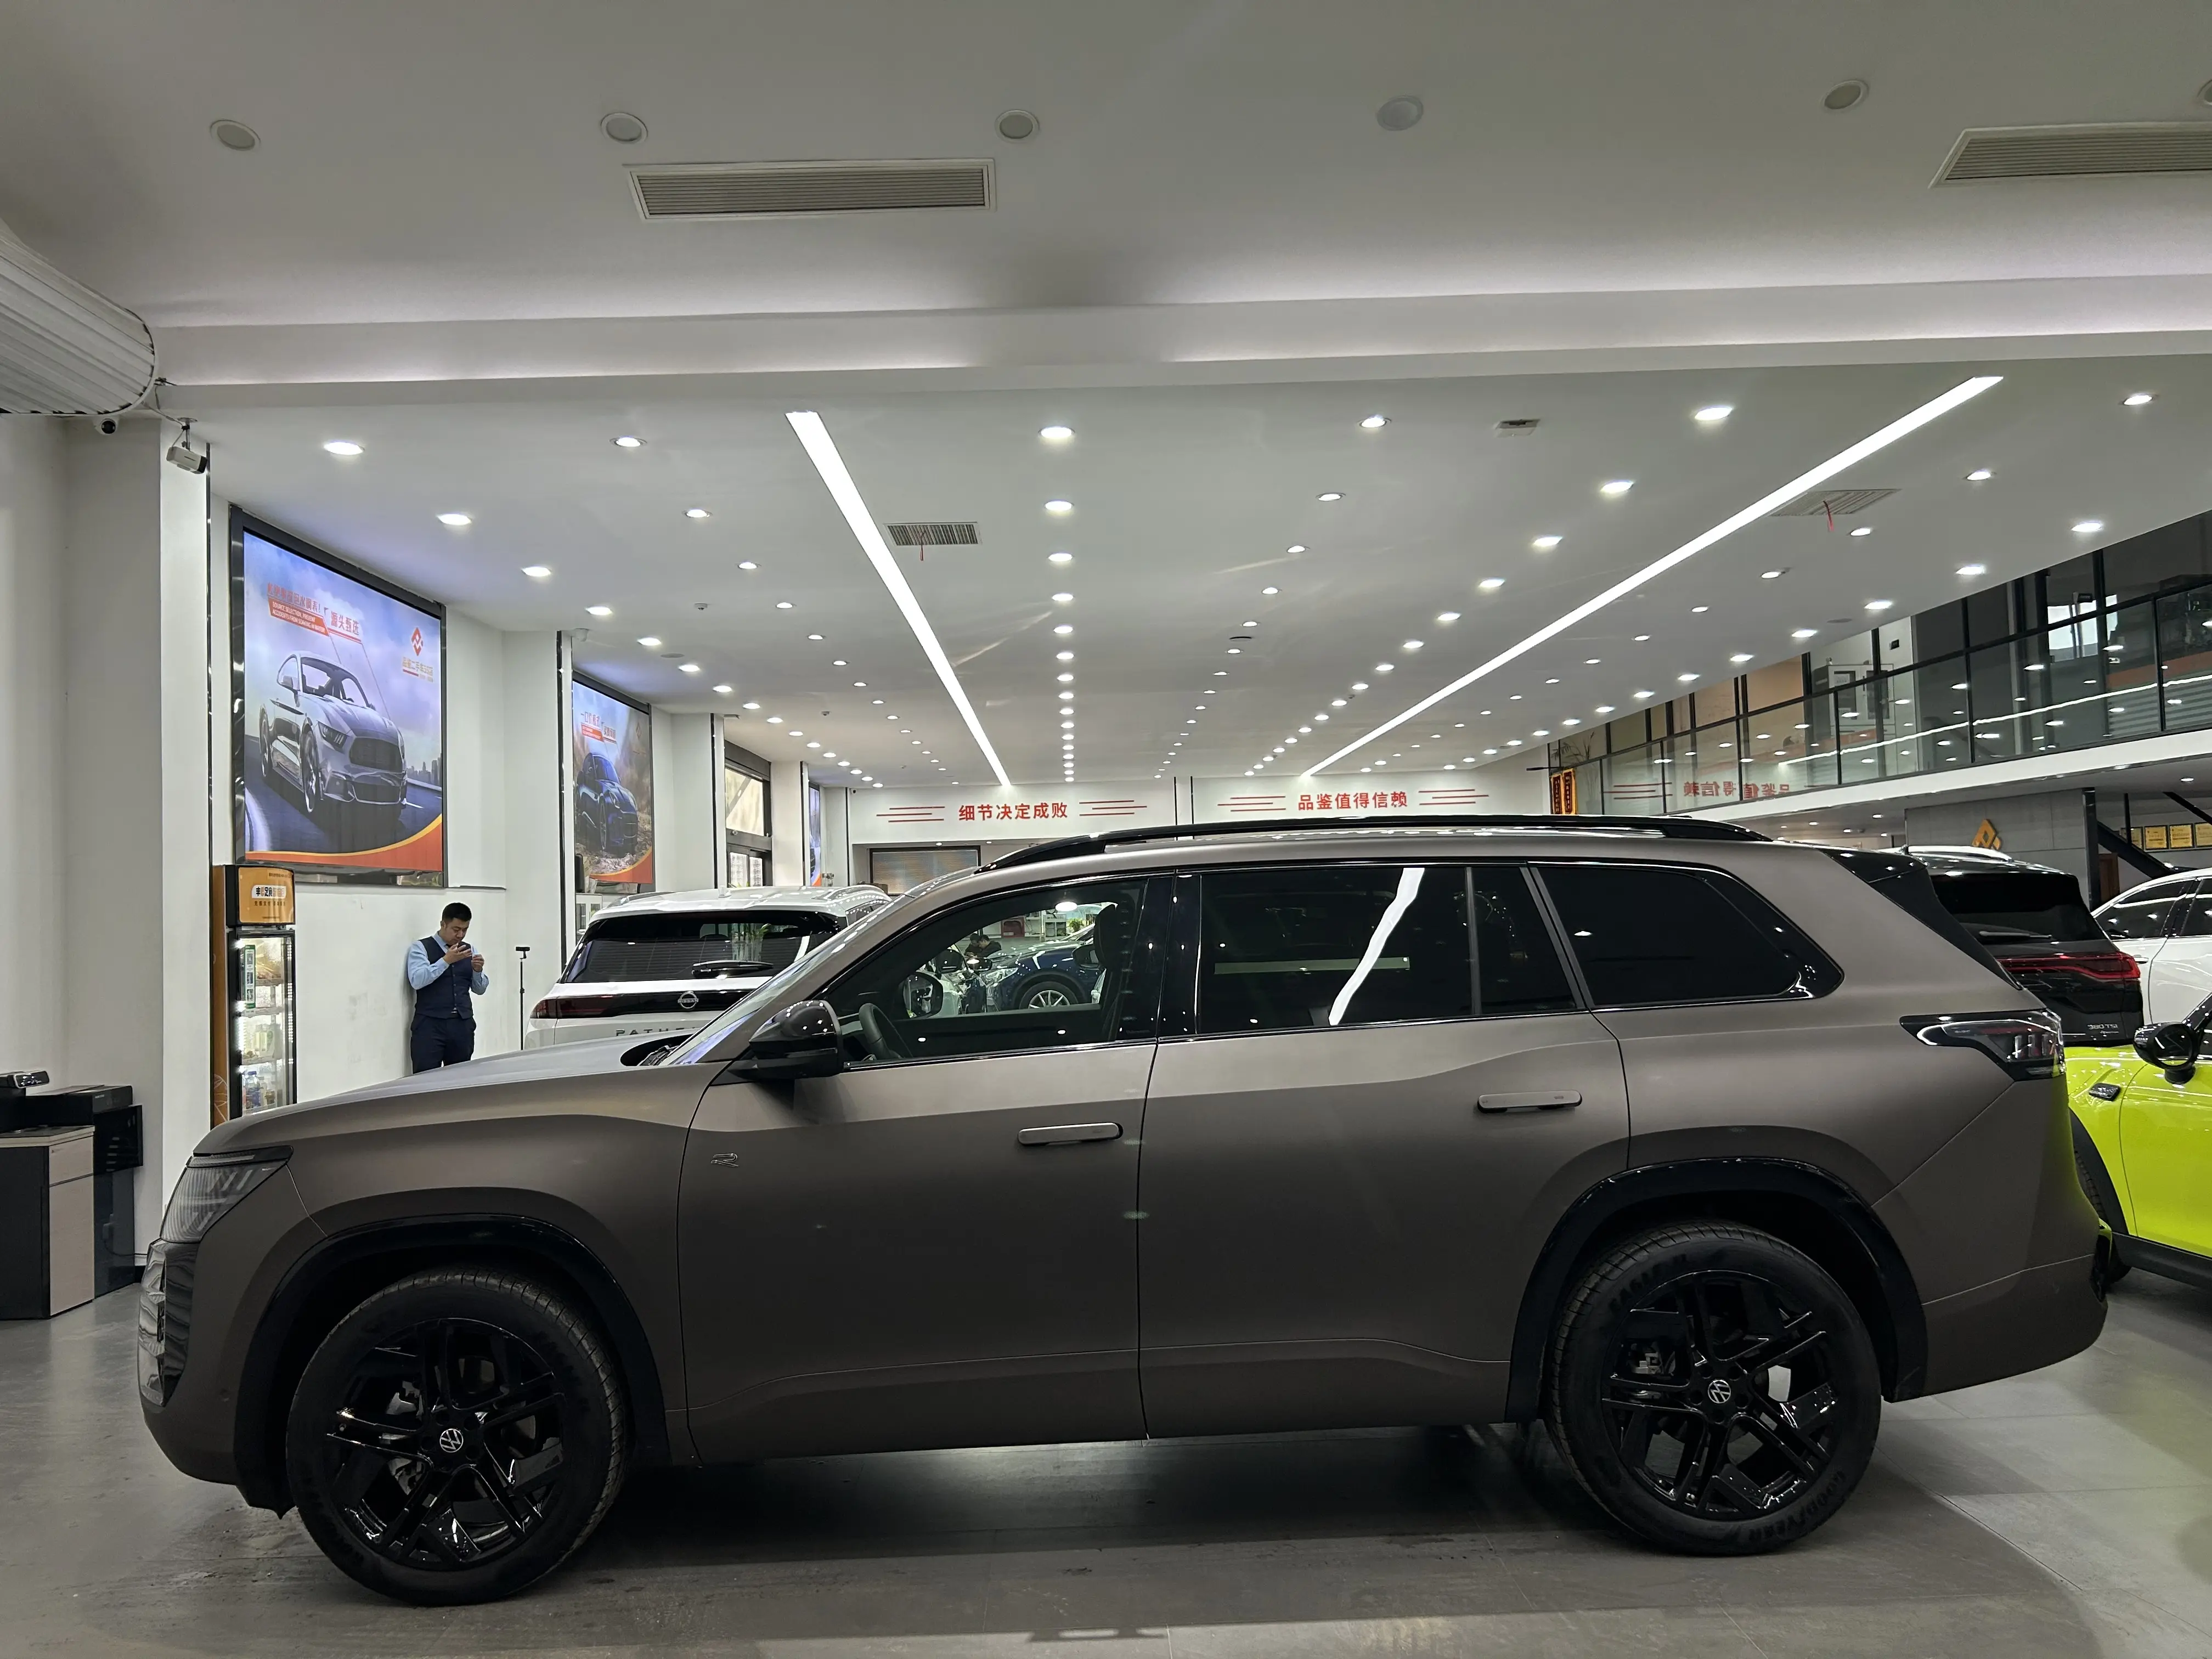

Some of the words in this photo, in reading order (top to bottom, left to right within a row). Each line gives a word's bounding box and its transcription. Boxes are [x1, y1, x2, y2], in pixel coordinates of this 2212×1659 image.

[331, 611, 359, 635] 源头甄选
[1298, 791, 1408, 811] 品鉴值得信赖
[958, 802, 1068, 821] 细节决定成败
